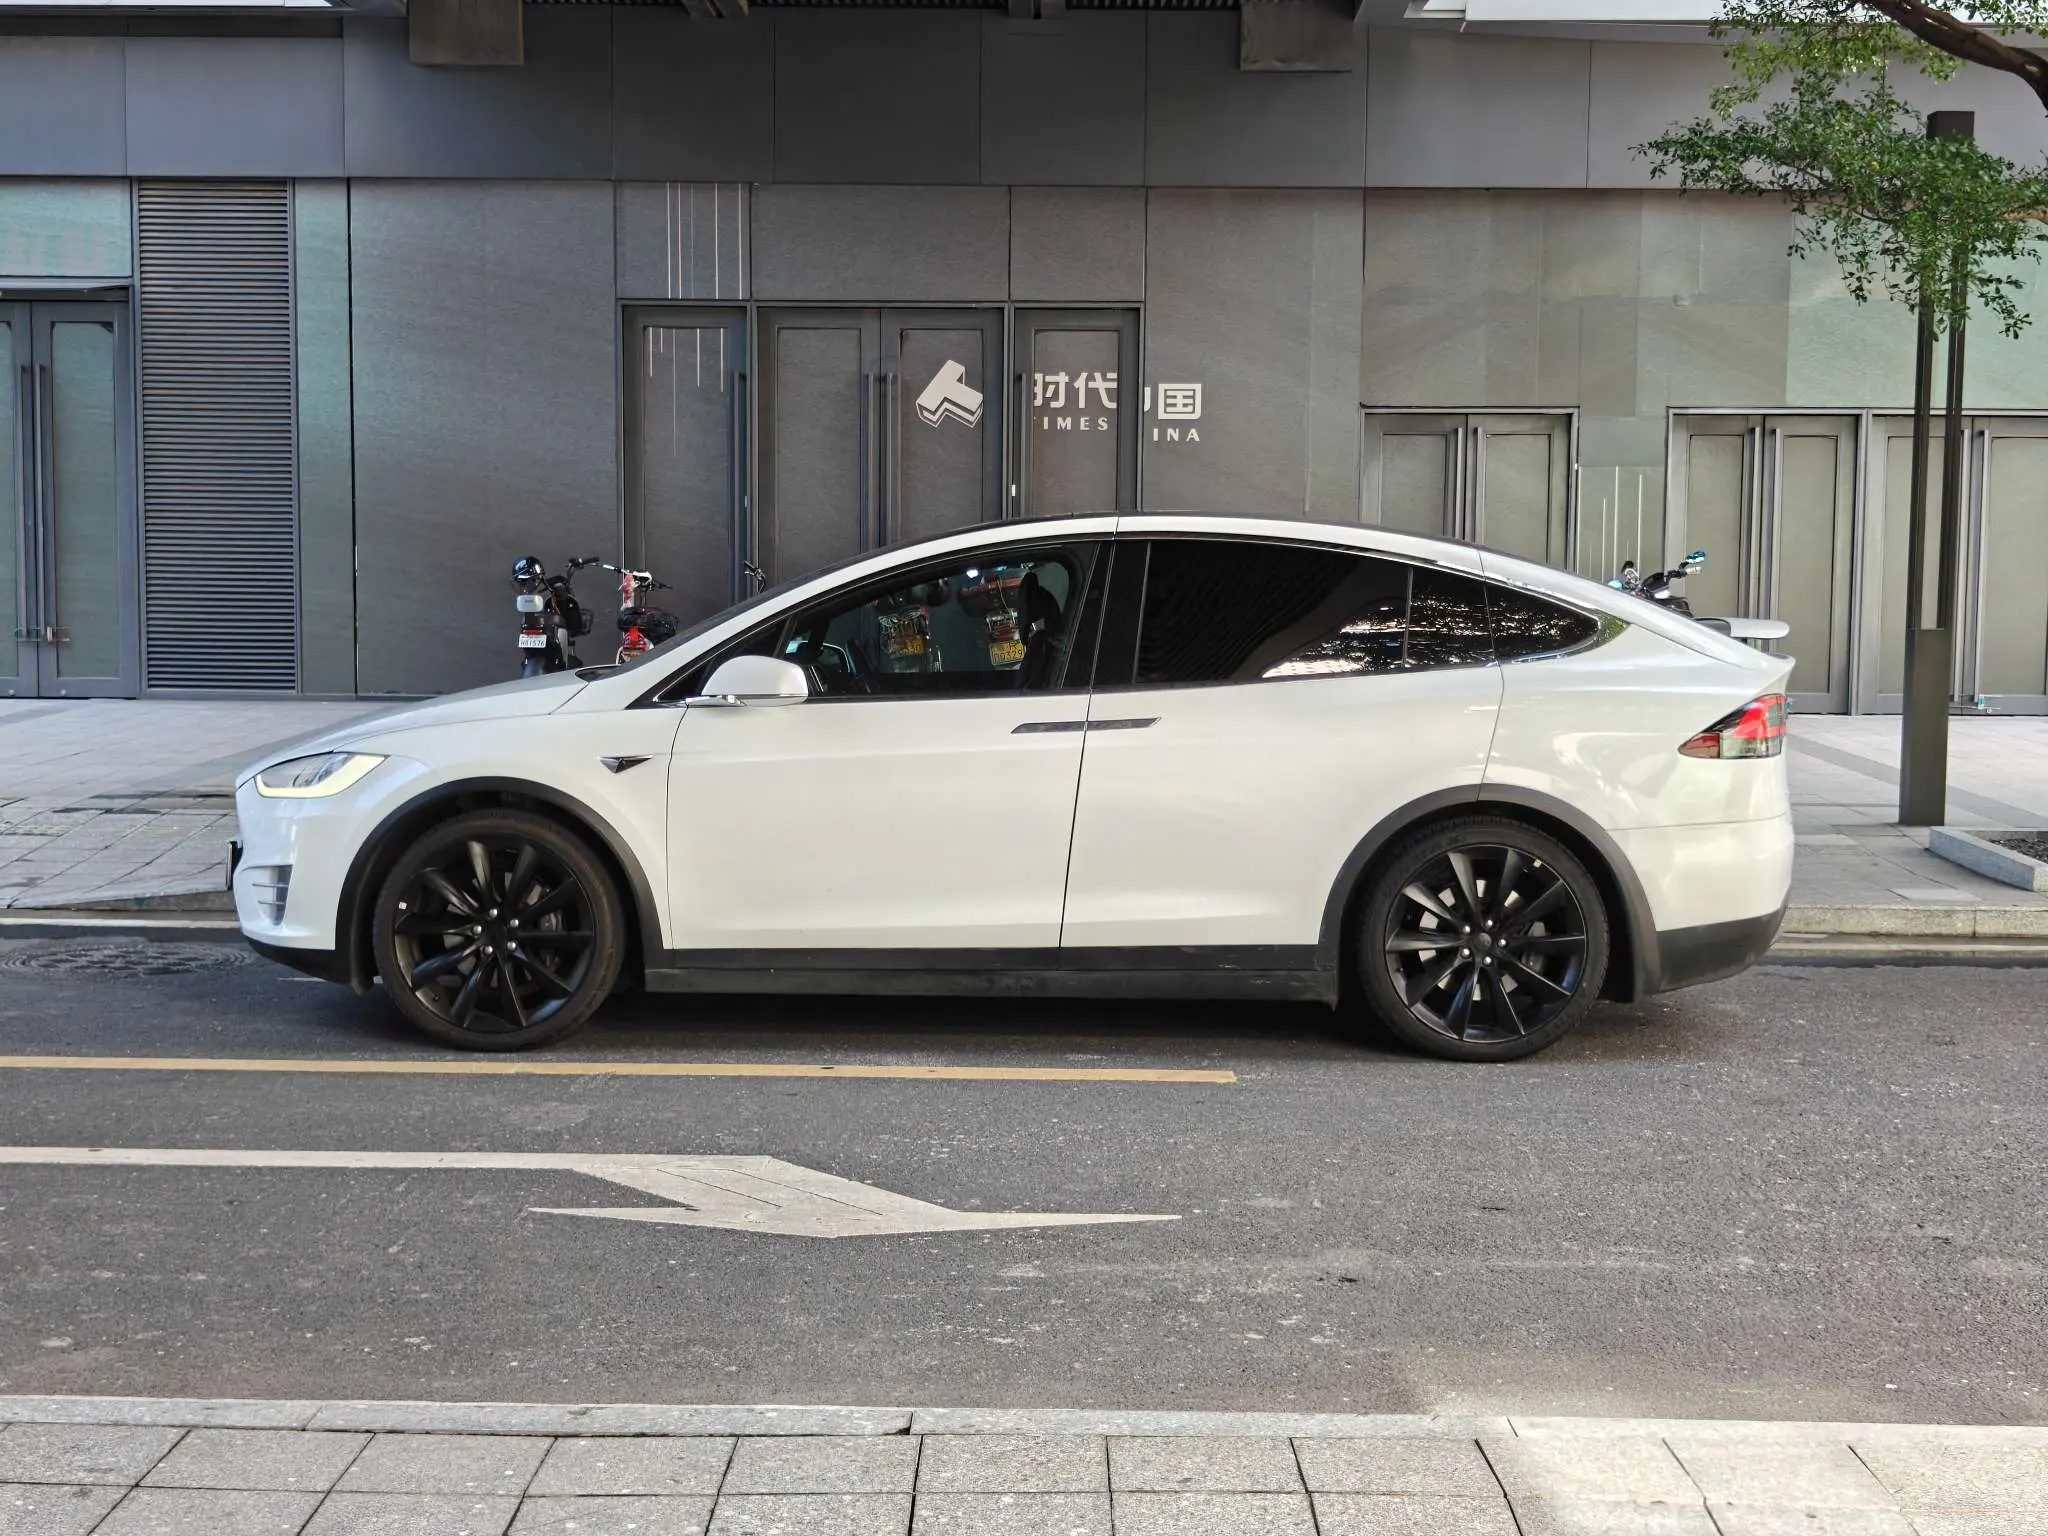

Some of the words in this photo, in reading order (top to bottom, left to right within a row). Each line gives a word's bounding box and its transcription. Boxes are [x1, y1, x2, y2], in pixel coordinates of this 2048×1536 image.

[1034, 371, 1117, 409] 时代
[1143, 383, 1202, 420] 国
[1034, 416, 1109, 431] IMES
[1152, 428, 1201, 442] INA
